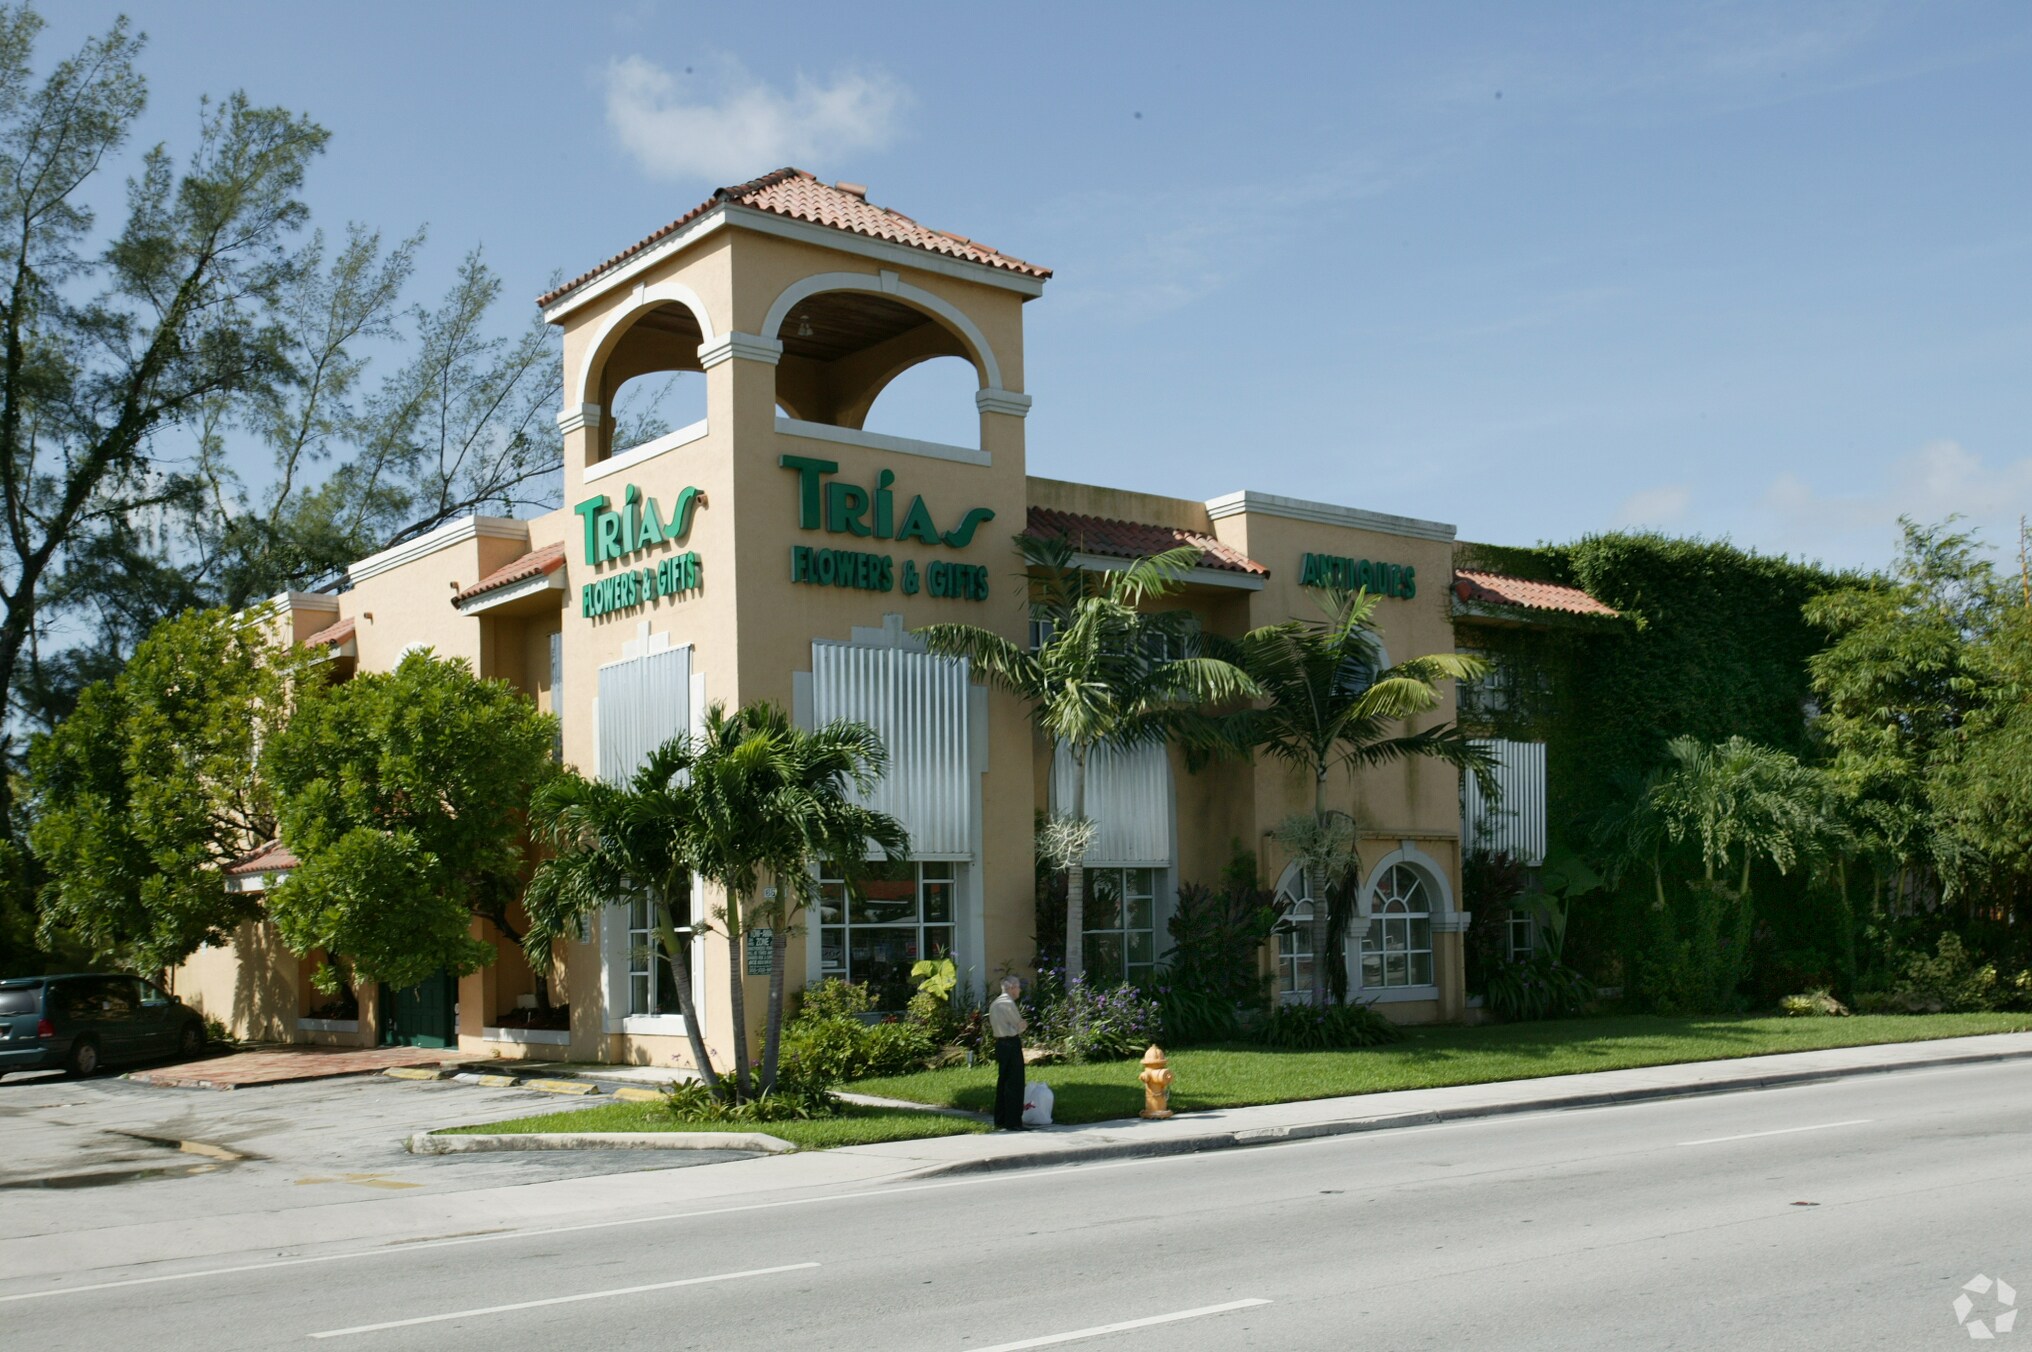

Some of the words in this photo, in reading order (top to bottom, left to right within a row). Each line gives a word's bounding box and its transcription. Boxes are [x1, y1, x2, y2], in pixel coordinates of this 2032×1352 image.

[582, 569, 640, 618] FLOWERS
[641, 567, 657, 601] &
[657, 550, 703, 597] GIFTS
[791, 545, 894, 592] FLOWERS
[902, 559, 920, 595] &
[927, 560, 989, 601] GIFTS
[1299, 552, 1416, 600] ANTIQUES
